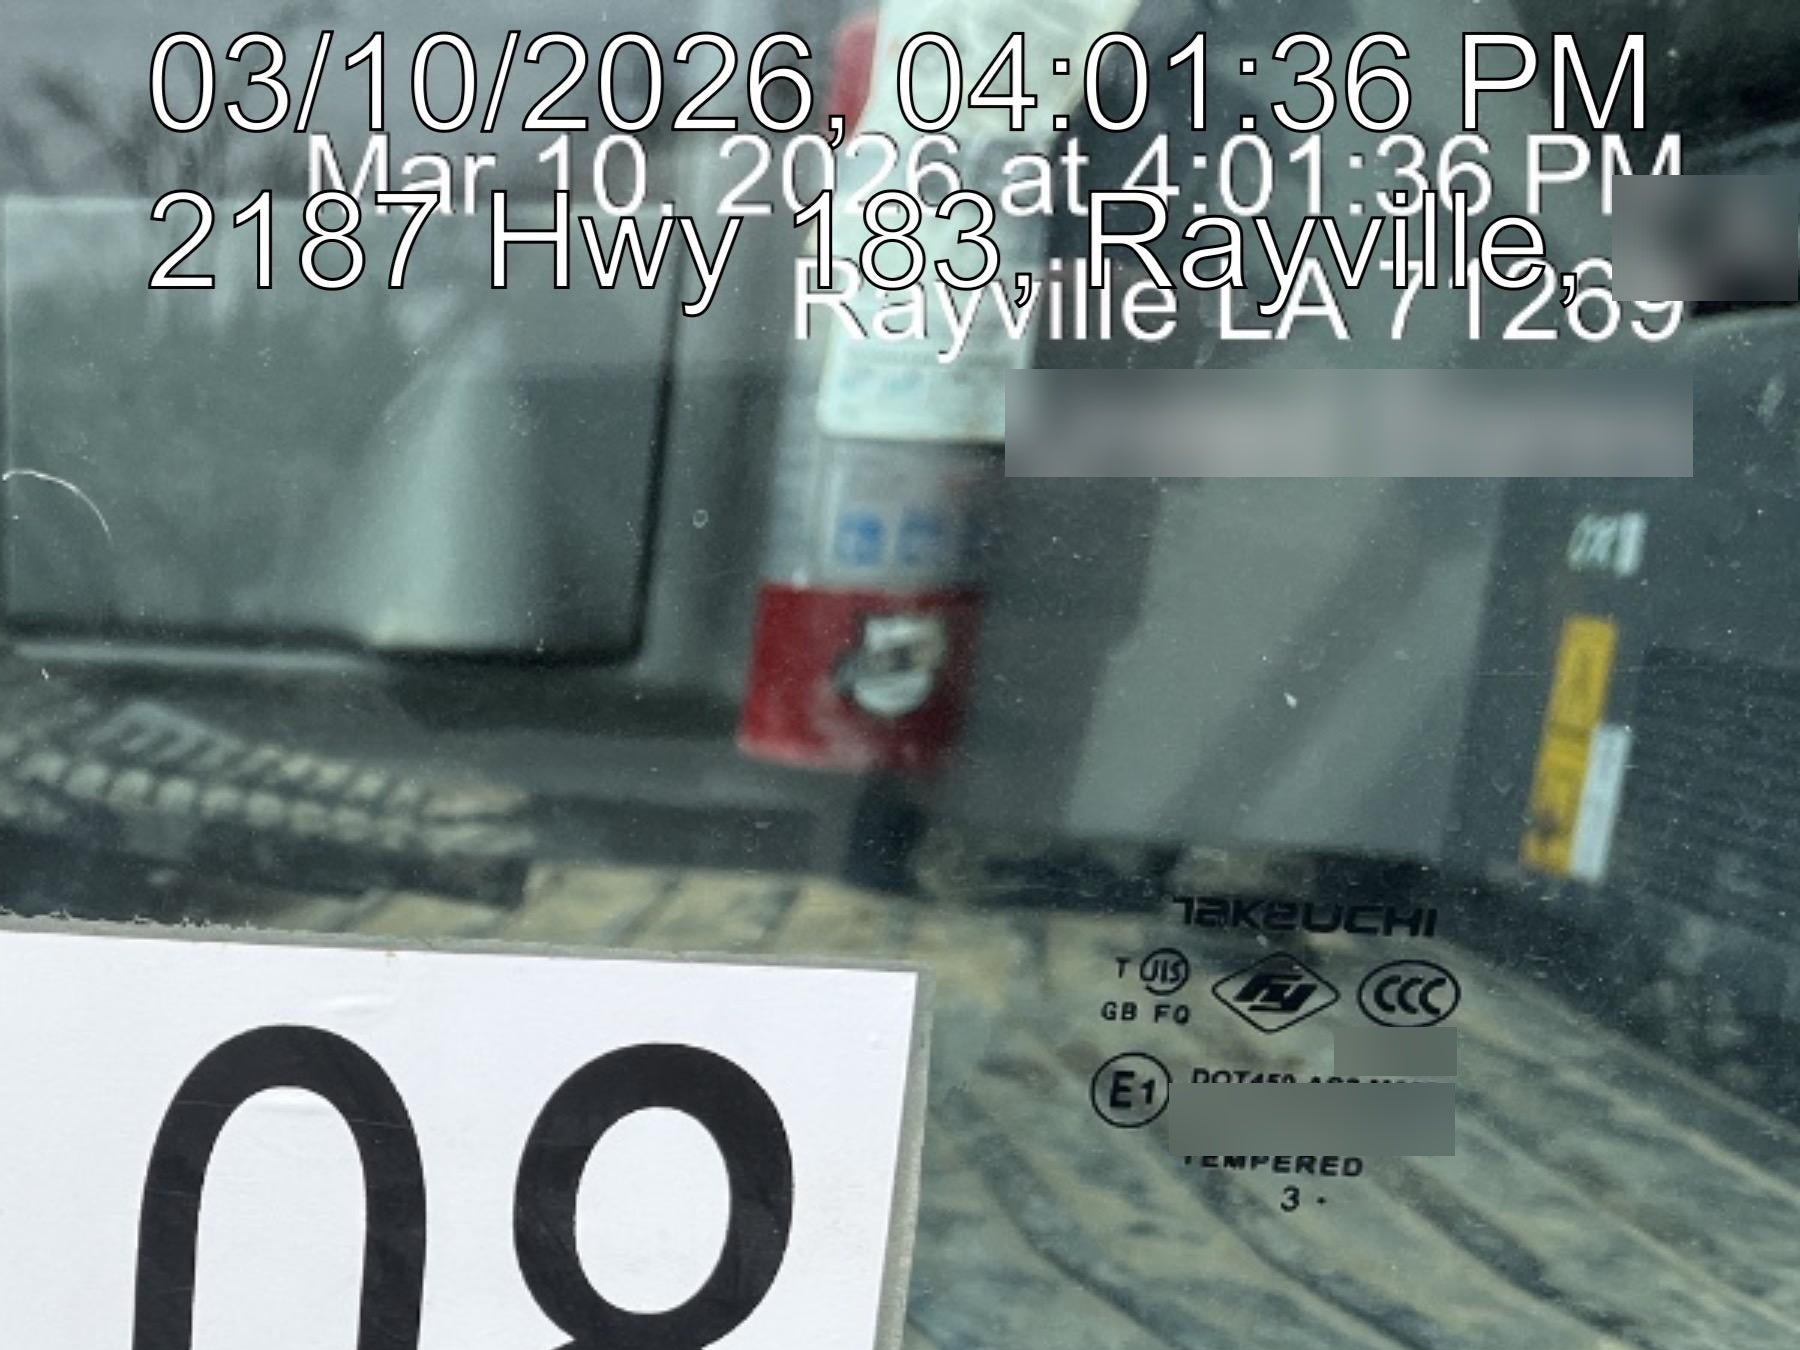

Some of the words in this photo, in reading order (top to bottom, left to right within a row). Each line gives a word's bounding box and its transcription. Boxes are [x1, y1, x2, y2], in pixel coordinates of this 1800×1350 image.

[1101, 1001, 1138, 1022] GB
[1374, 974, 1447, 1016] CCC
[1109, 1070, 1157, 1109] E1
[1280, 1184, 1300, 1213] 3
